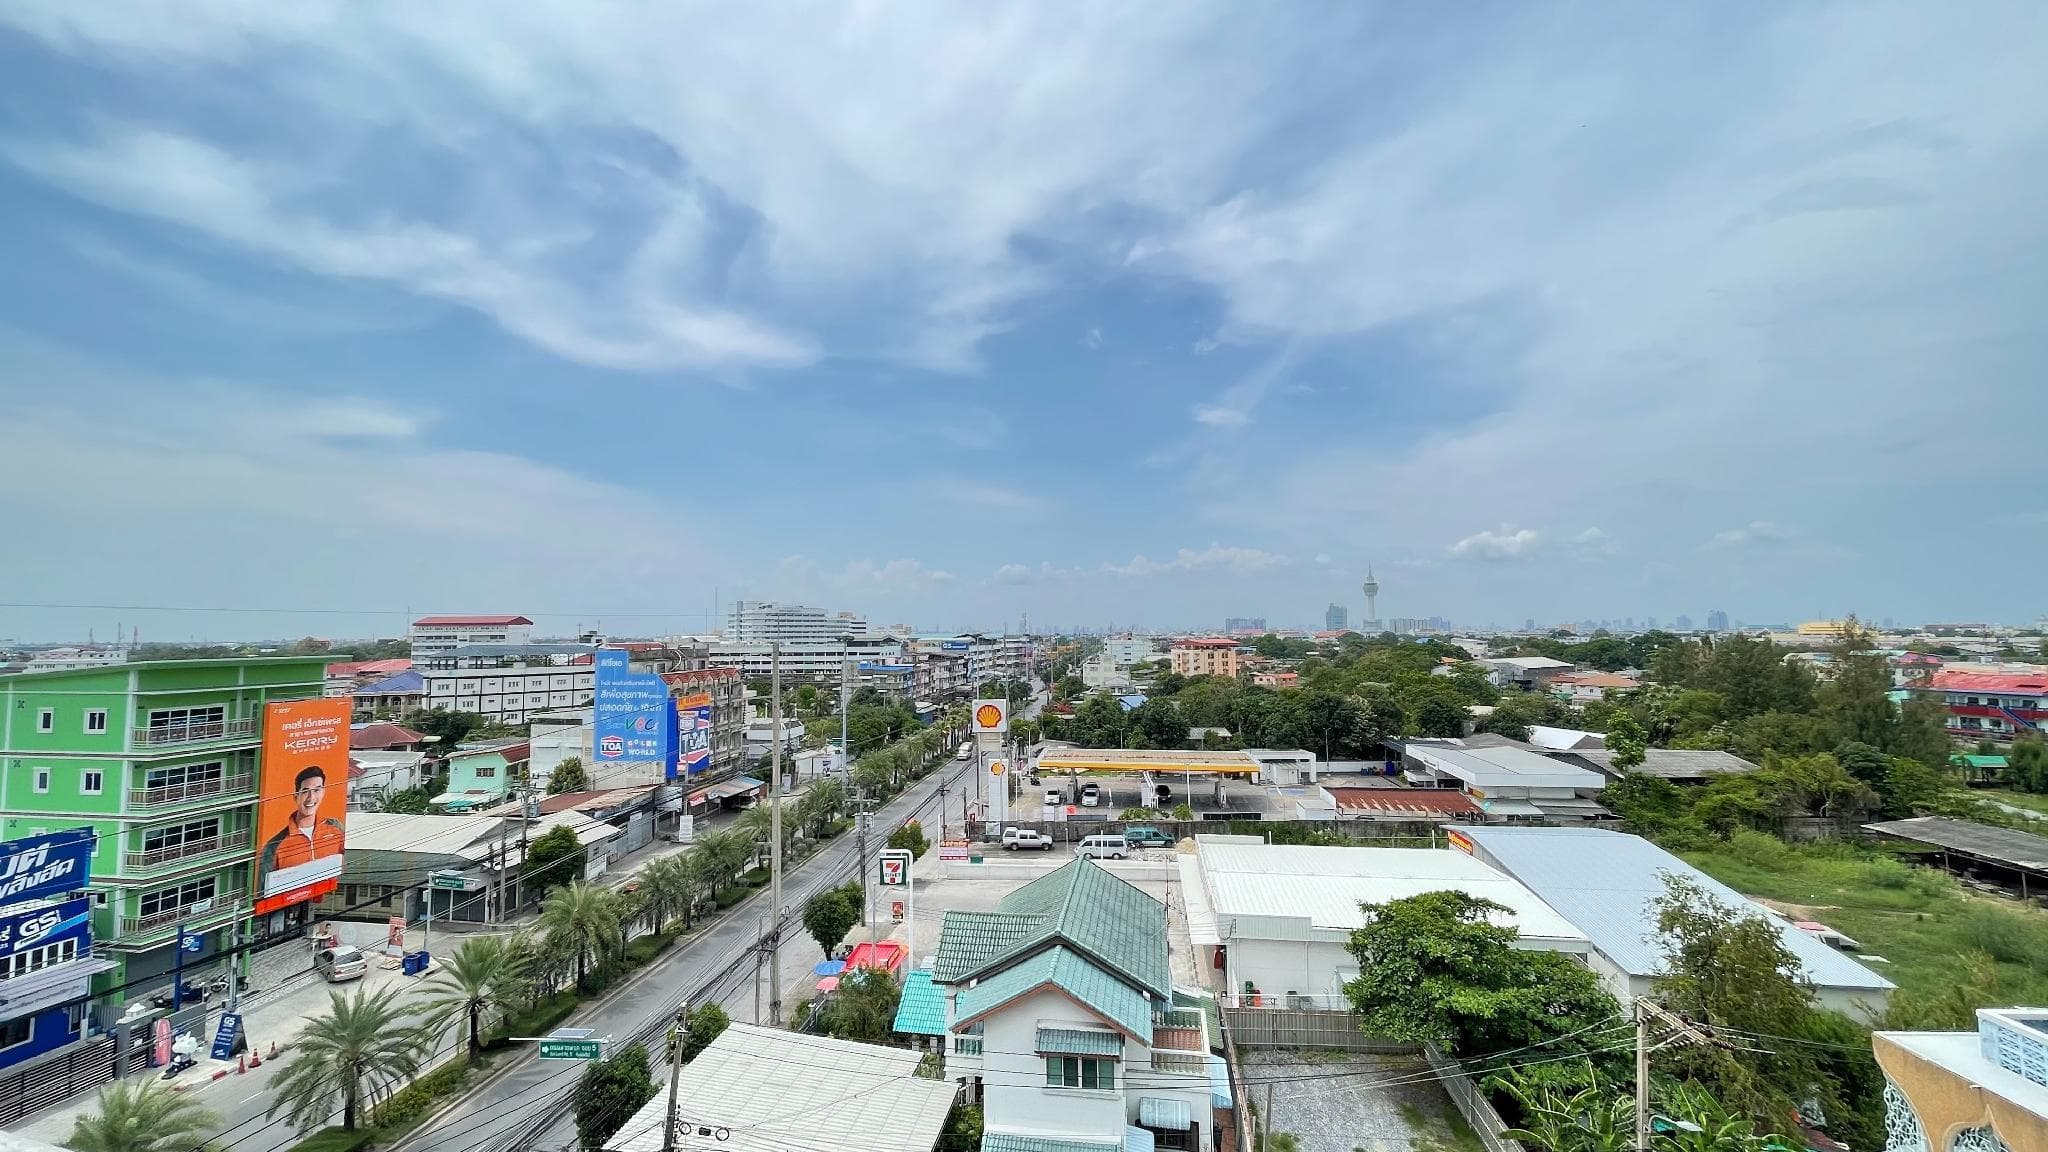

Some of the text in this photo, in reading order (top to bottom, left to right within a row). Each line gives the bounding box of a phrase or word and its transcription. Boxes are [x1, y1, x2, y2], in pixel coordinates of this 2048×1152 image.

[284, 735, 338, 750] KERRY
[601, 742, 622, 751] TOA
[627, 748, 656, 756] WORLD
[19, 910, 57, 937] GS
[591, 1044, 597, 1052] 5
